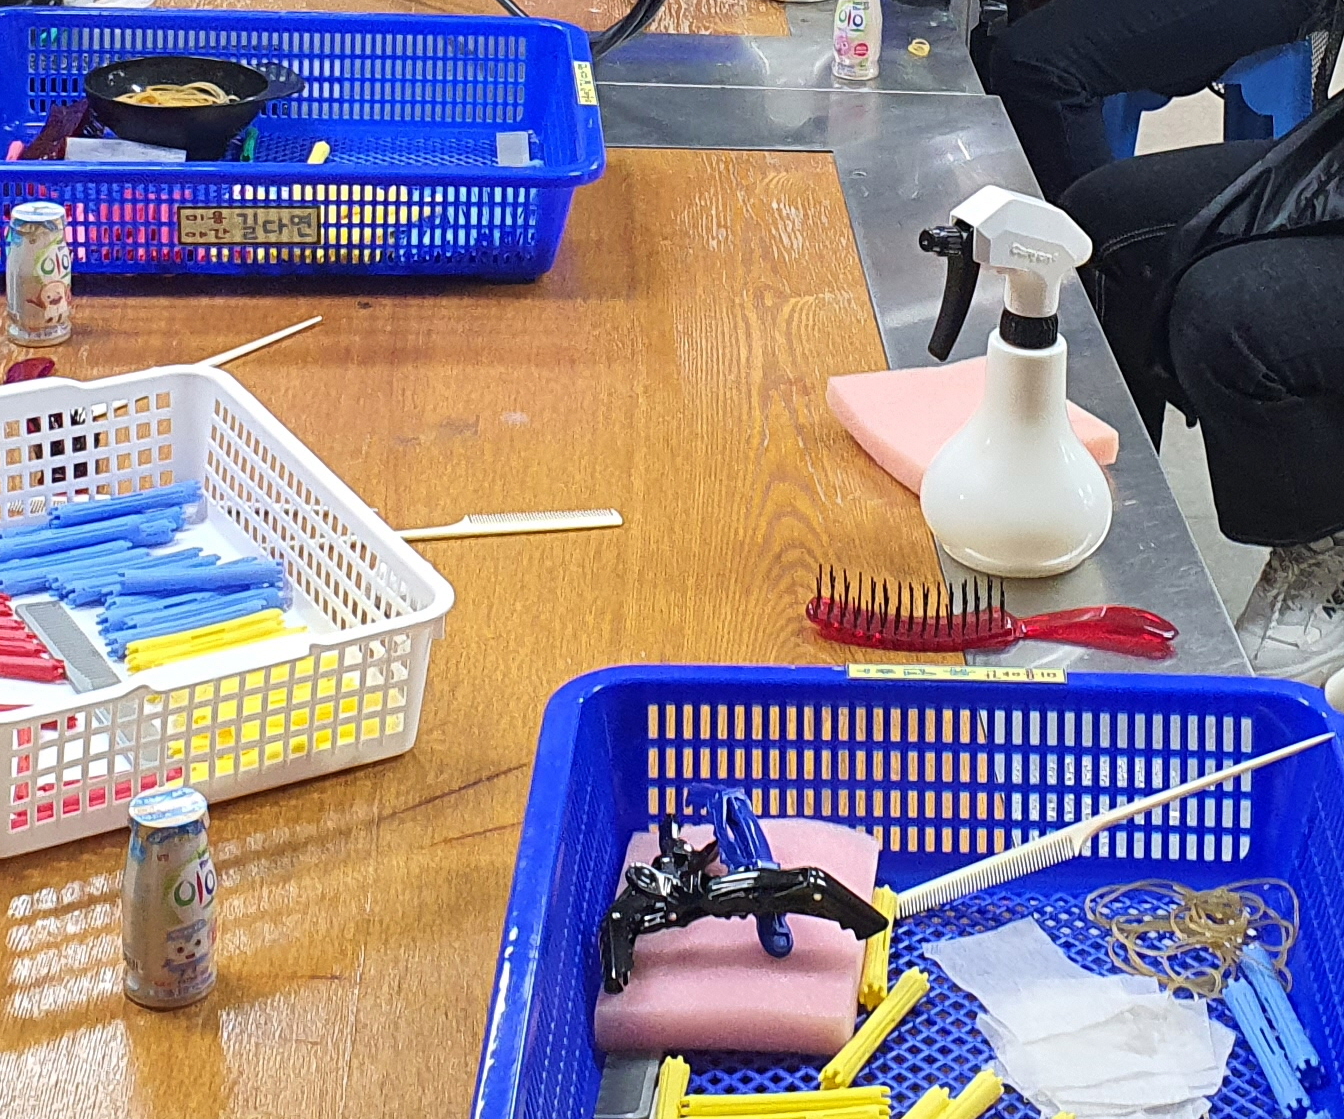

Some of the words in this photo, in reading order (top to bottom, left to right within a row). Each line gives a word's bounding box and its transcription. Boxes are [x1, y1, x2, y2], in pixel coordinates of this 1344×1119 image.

[184, 228, 230, 240] 야간
[236, 212, 313, 241] 길다연
[185, 210, 227, 225] 미용
